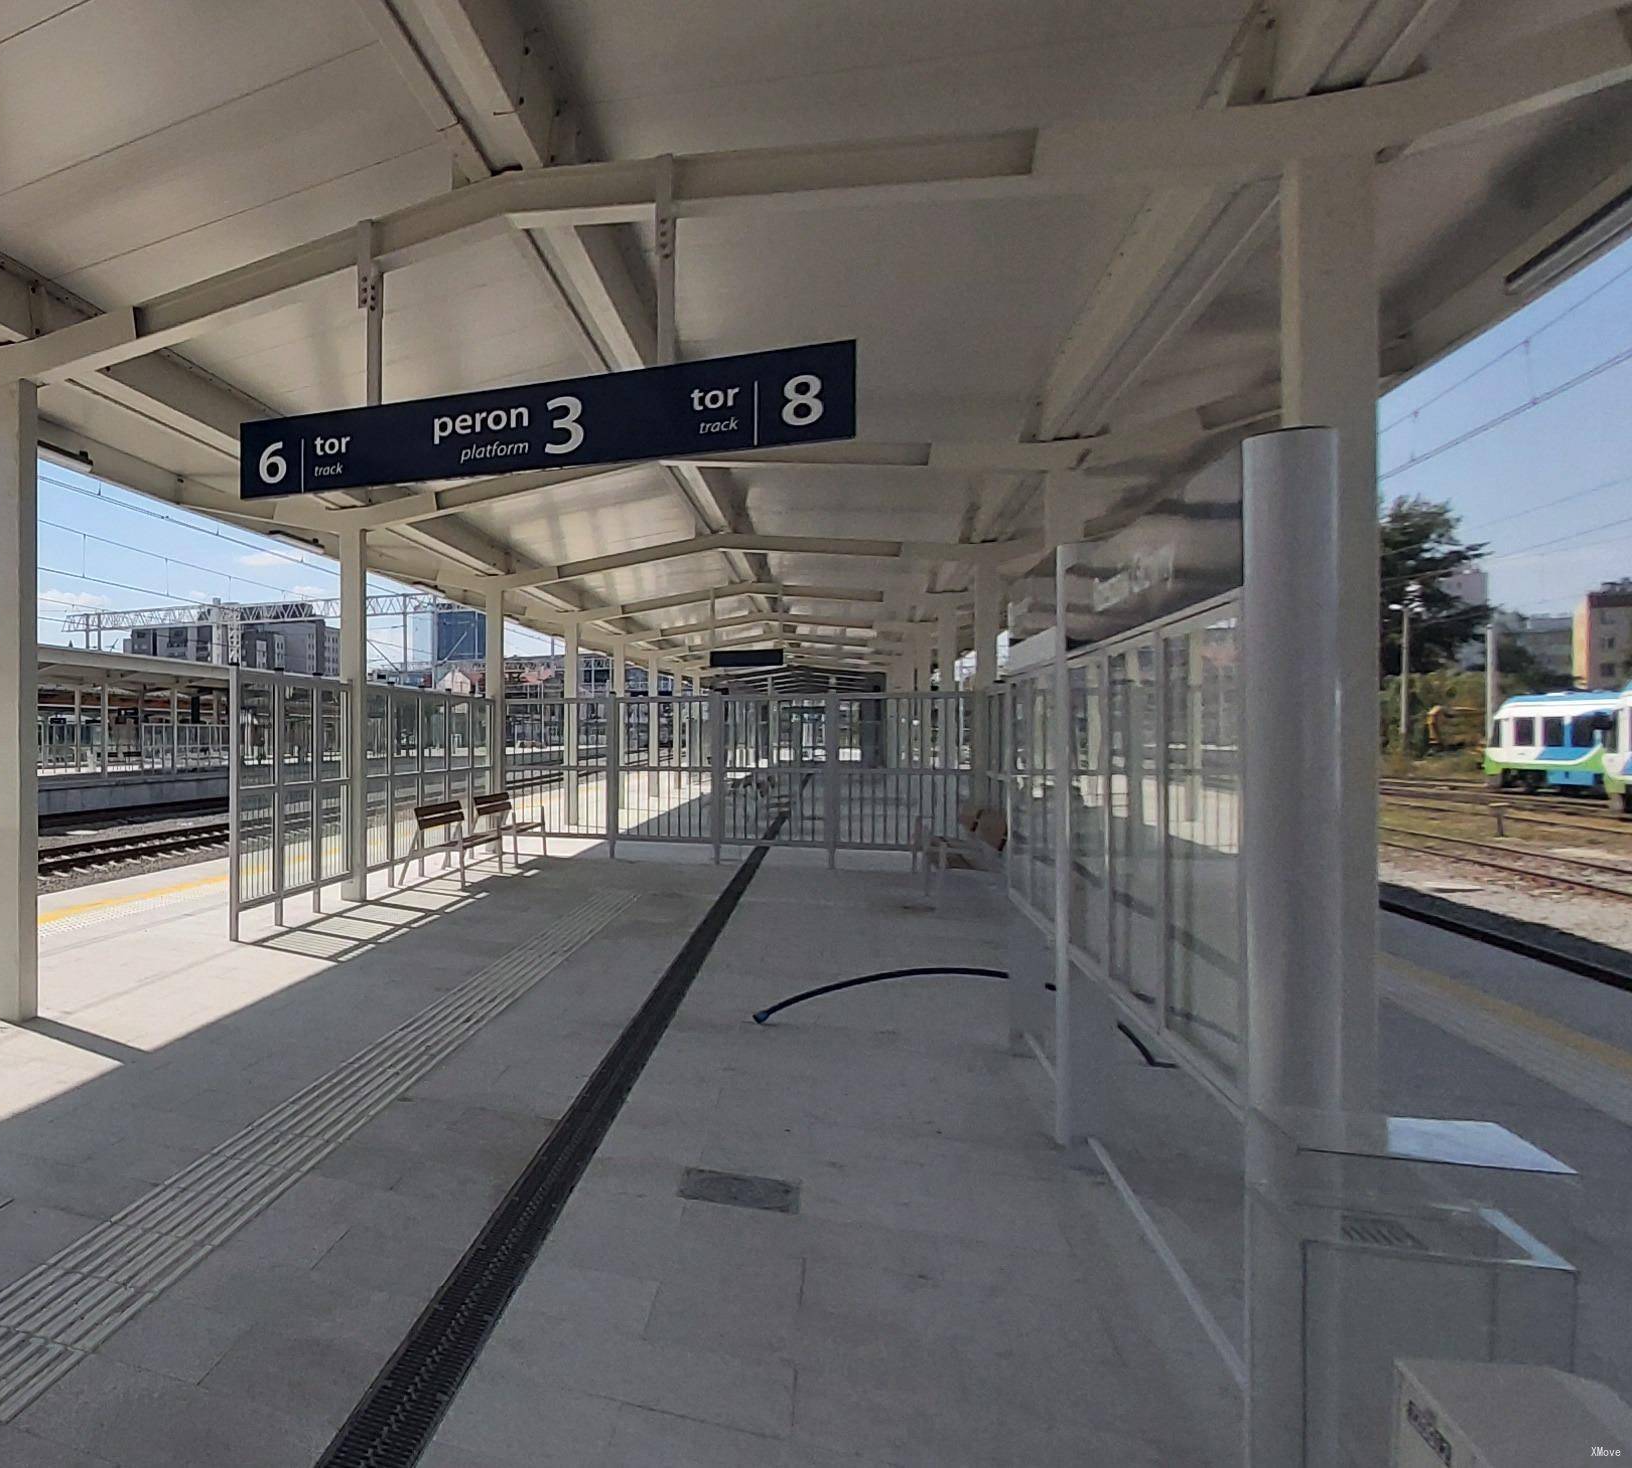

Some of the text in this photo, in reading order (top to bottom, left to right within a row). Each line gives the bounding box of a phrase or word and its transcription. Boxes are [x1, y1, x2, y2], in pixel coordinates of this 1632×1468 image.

[690, 374, 823, 426] tor 8
[433, 396, 585, 455] peron 3
[699, 417, 738, 435] track
[258, 434, 351, 484] 6 tor
[460, 439, 529, 463] platform
[313, 462, 344, 478] track
